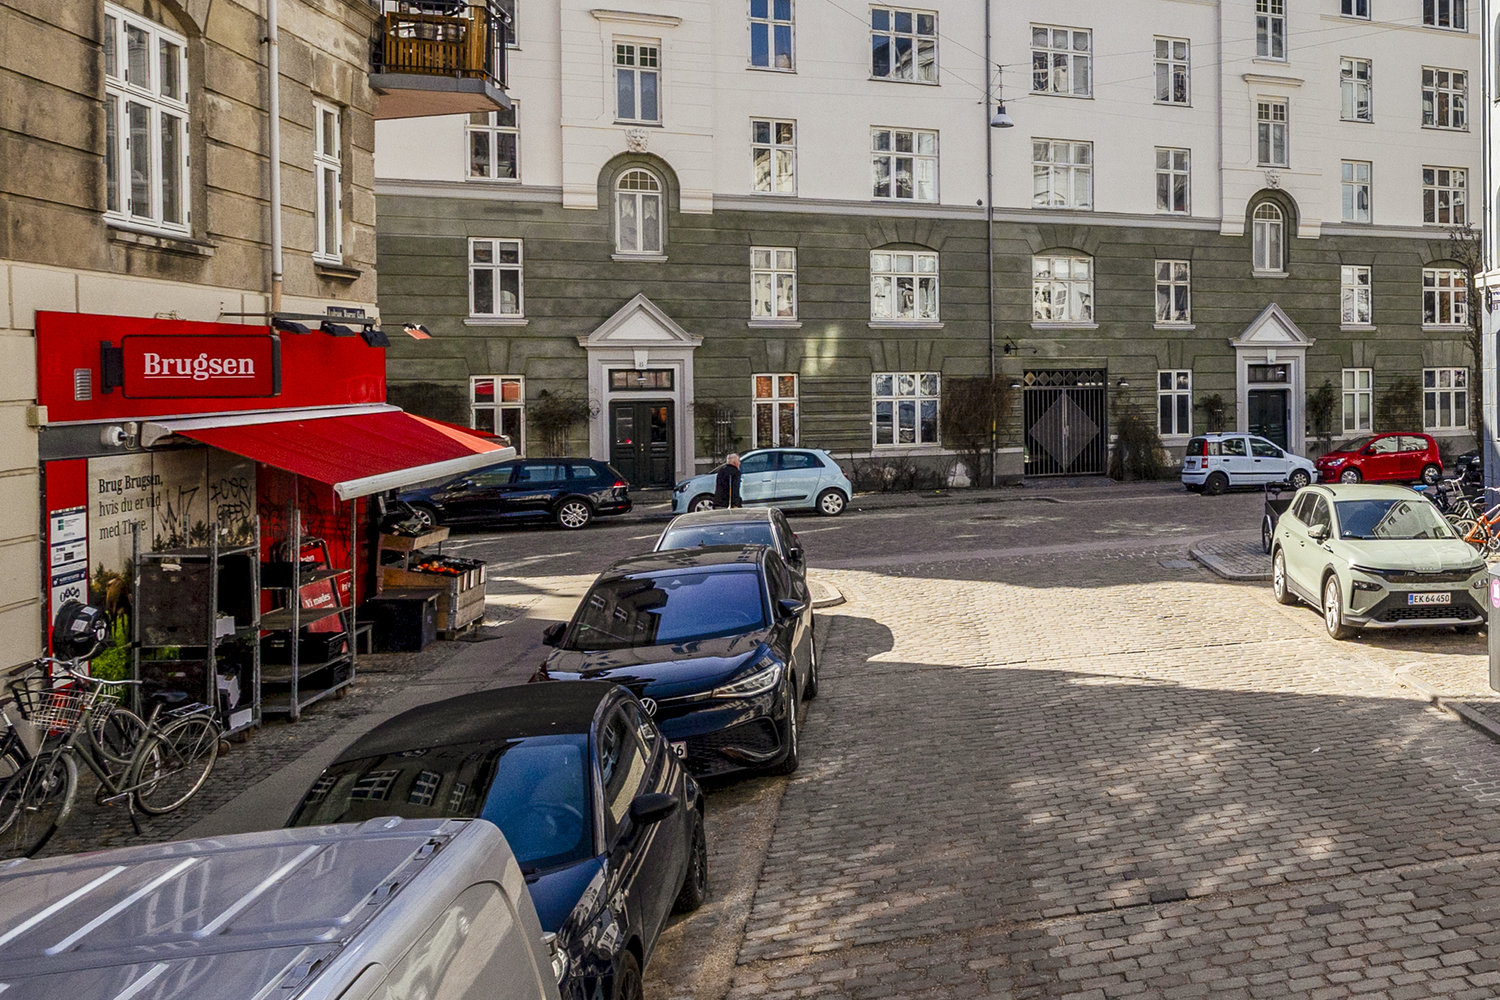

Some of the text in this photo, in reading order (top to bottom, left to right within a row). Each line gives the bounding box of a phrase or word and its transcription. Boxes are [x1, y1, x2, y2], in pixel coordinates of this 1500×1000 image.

[143, 352, 255, 381] Brugsen
[98, 478, 123, 495] Brug
[98, 499, 119, 517] hvis
[121, 496, 133, 513] du
[135, 498, 145, 510] er
[99, 520, 120, 540] med
[122, 518, 148, 535] The.
[1414, 594, 1450, 603] EK 64 450
